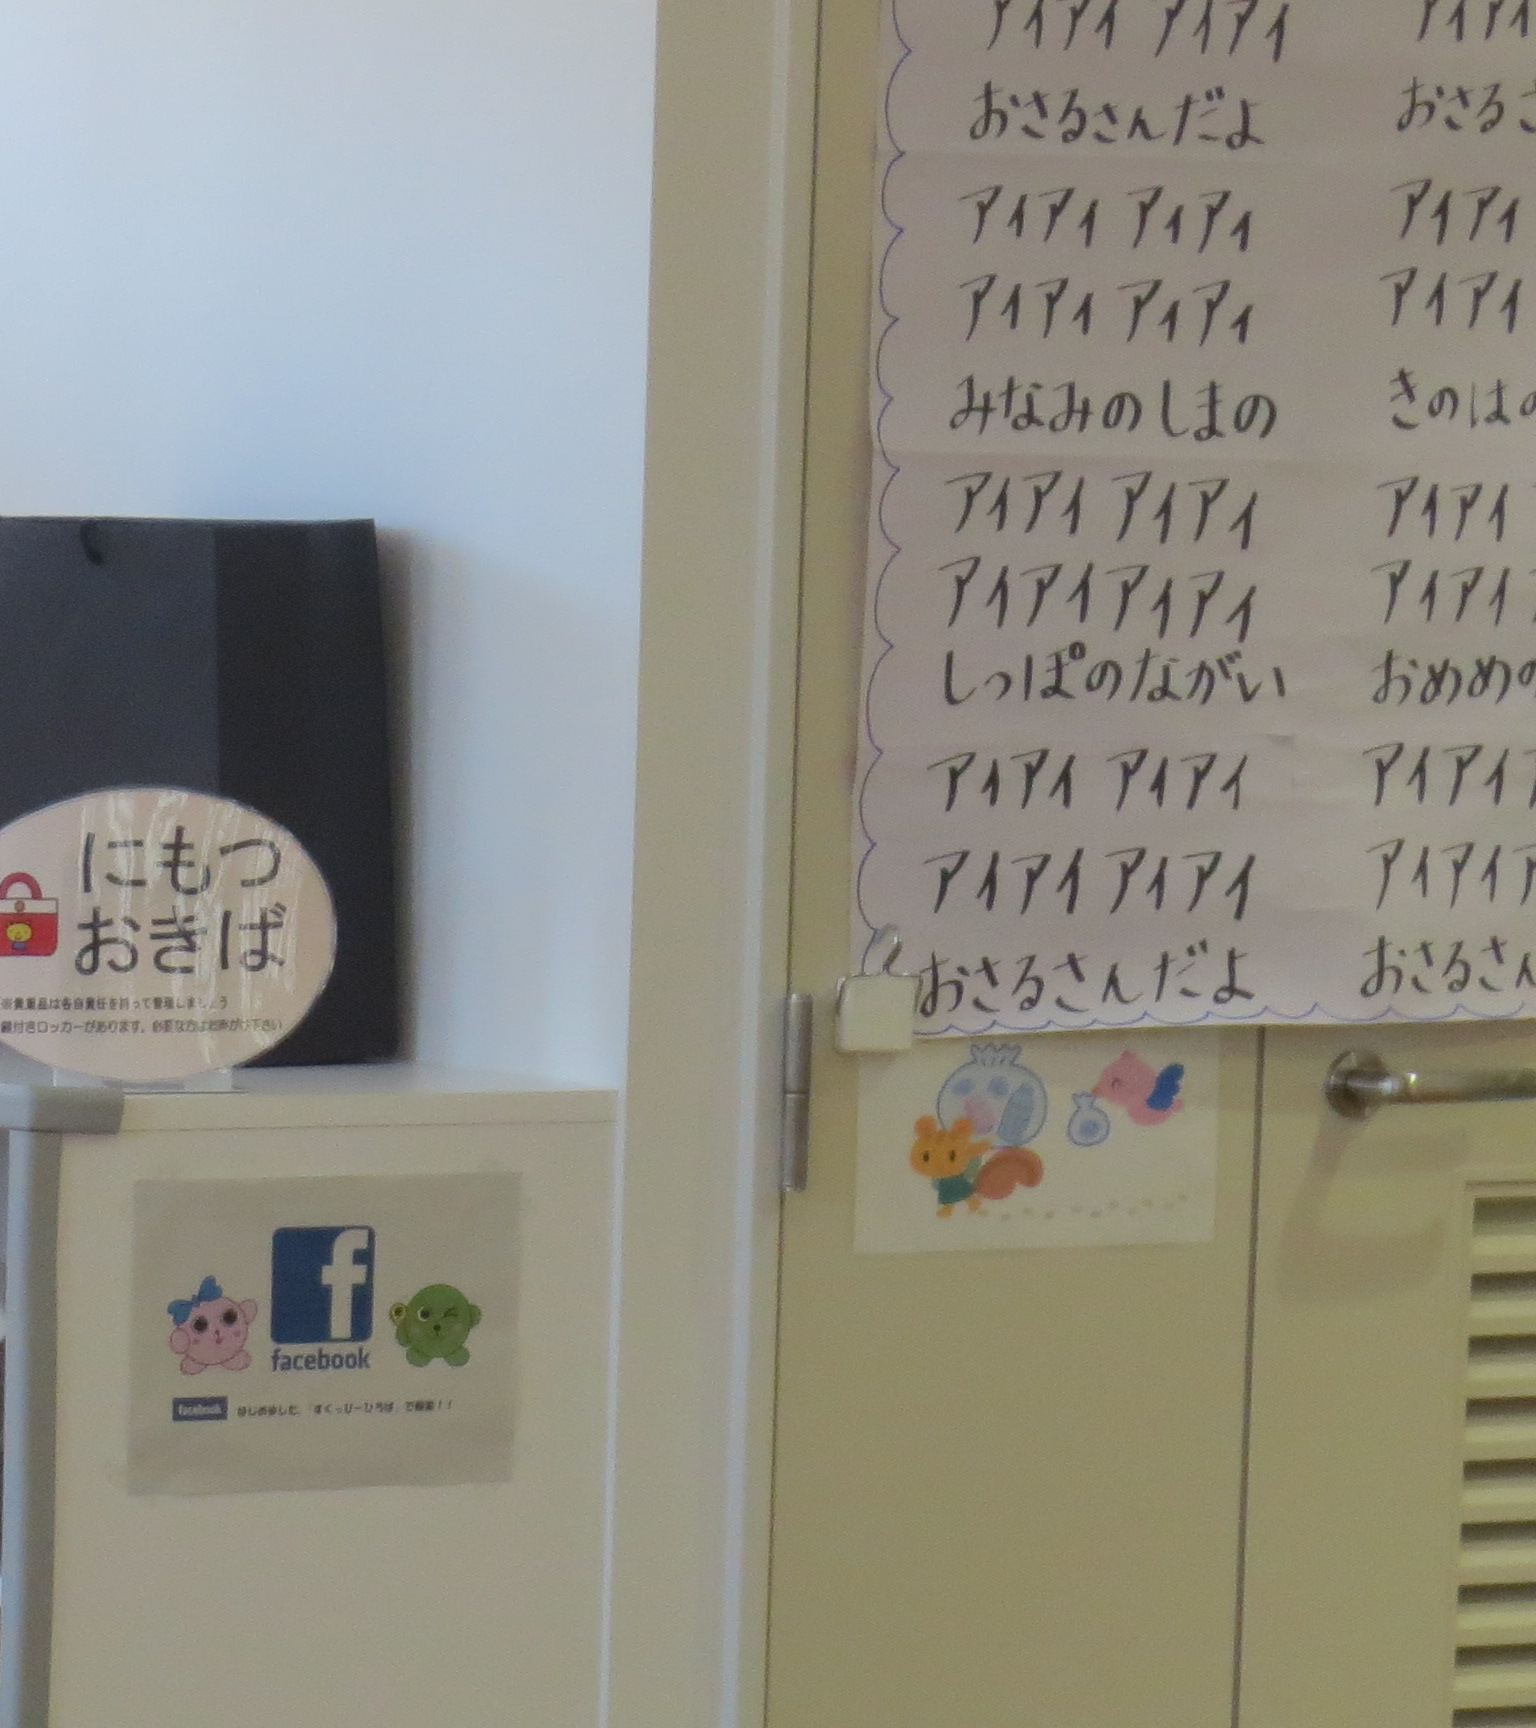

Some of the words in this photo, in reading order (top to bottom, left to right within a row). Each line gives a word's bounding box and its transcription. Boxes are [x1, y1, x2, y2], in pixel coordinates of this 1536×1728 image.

[969, 80, 1265, 151] おさるさんだよ
[948, 374, 1278, 443] みなみのしまの
[944, 641, 1286, 706] しっぽのながい
[81, 825, 282, 896] にもつ
[73, 902, 288, 976] おきば
[919, 938, 1254, 1018] おさるさんだよ
[272, 1348, 371, 1372] facebook
